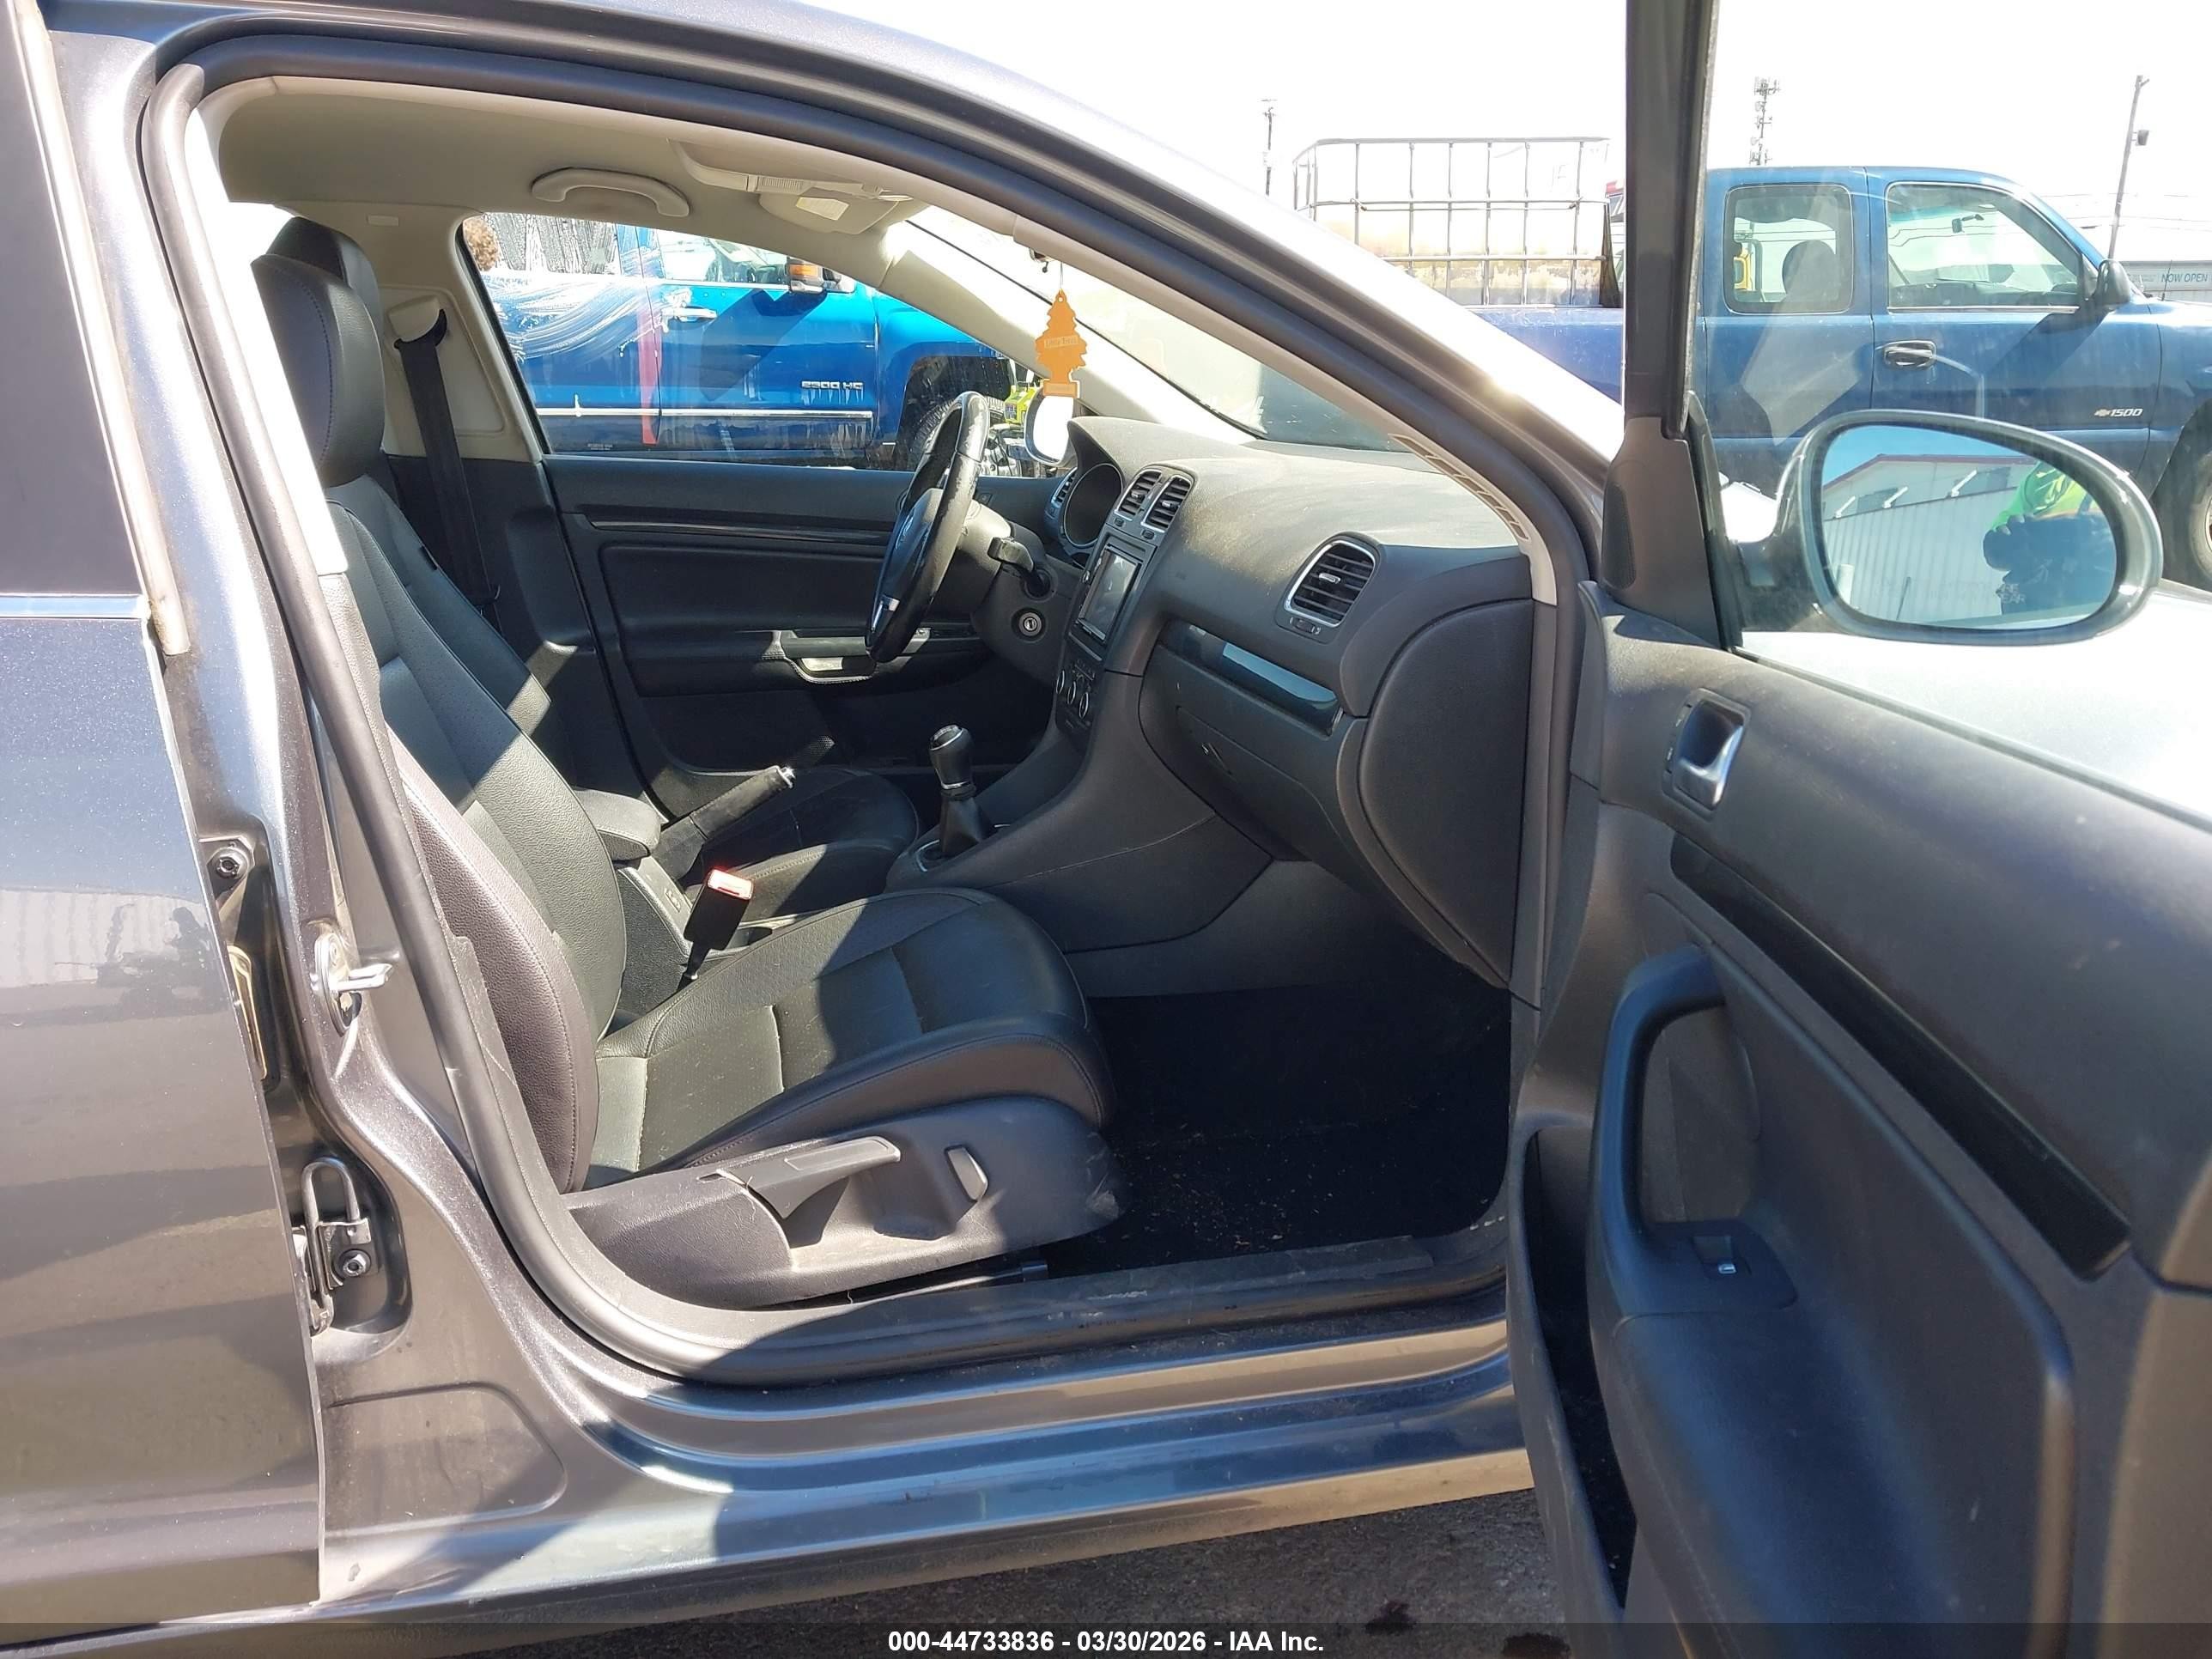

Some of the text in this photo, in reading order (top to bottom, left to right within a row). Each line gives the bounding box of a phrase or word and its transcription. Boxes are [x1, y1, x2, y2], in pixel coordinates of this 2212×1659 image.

[2160, 273, 2183, 283] NOW
[2184, 273, 2209, 283] OPEN
[2110, 408, 2143, 417] 1500
